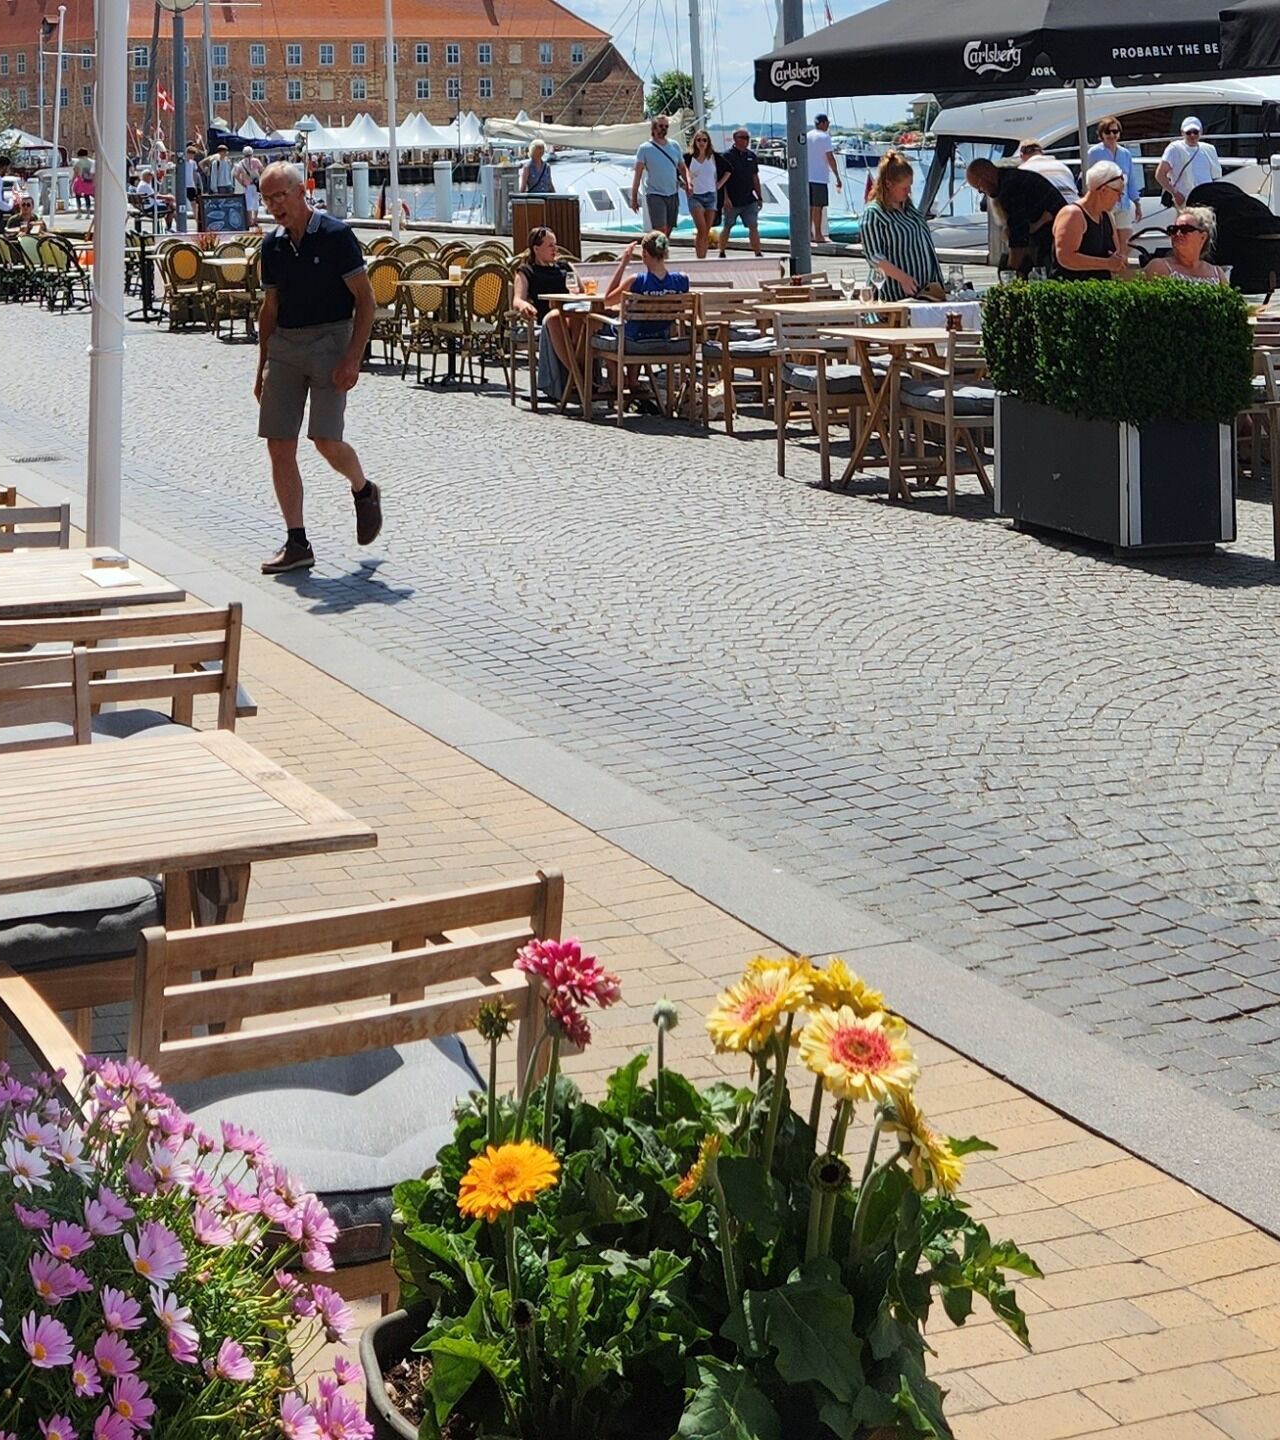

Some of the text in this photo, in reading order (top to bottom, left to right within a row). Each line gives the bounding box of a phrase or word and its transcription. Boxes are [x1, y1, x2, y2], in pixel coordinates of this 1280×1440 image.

[963, 40, 1022, 75] Carlsberg
[1112, 42, 1220, 59] PROBABLY THE BE
[770, 59, 821, 91] Carlsberg
